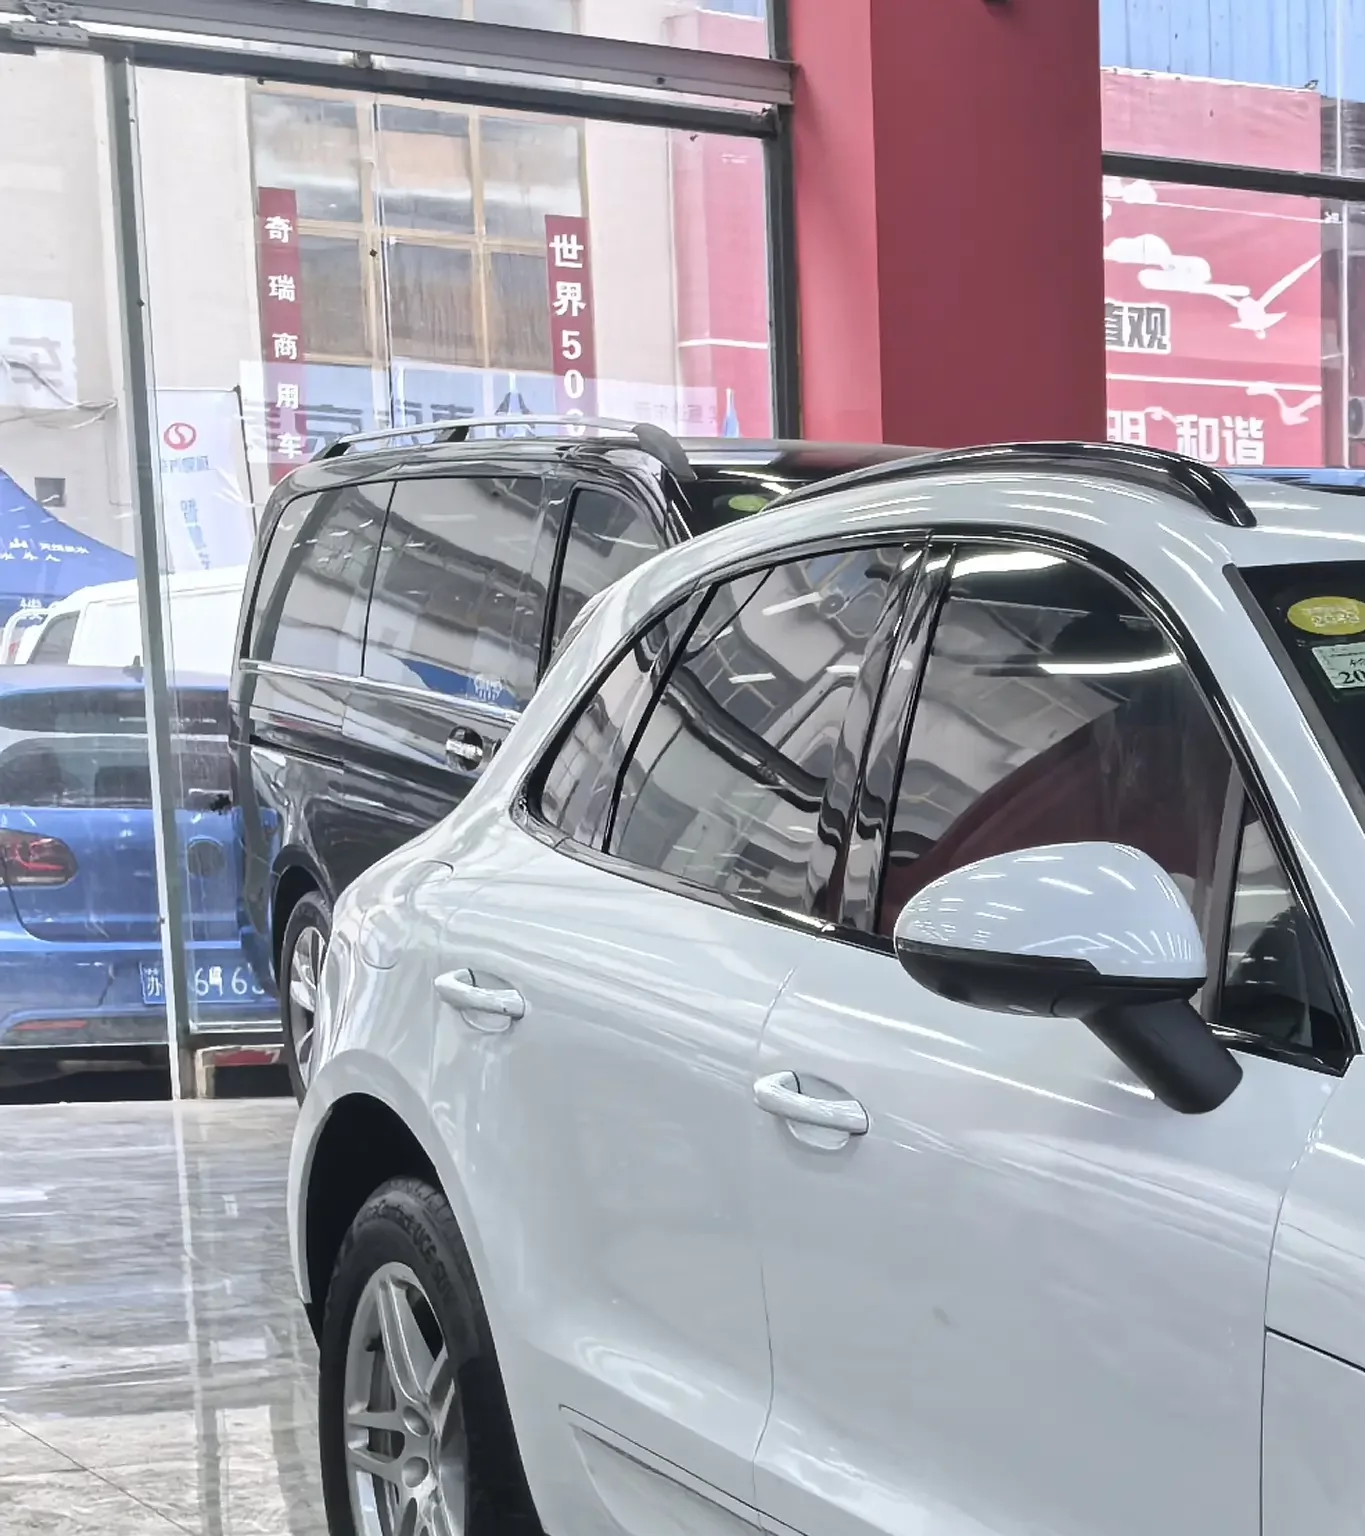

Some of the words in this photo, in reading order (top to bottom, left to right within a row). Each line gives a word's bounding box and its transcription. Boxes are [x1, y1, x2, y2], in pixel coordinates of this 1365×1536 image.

[264, 215, 305, 460] 奇瑞商用车
[1176, 415, 1265, 465] 和谐
